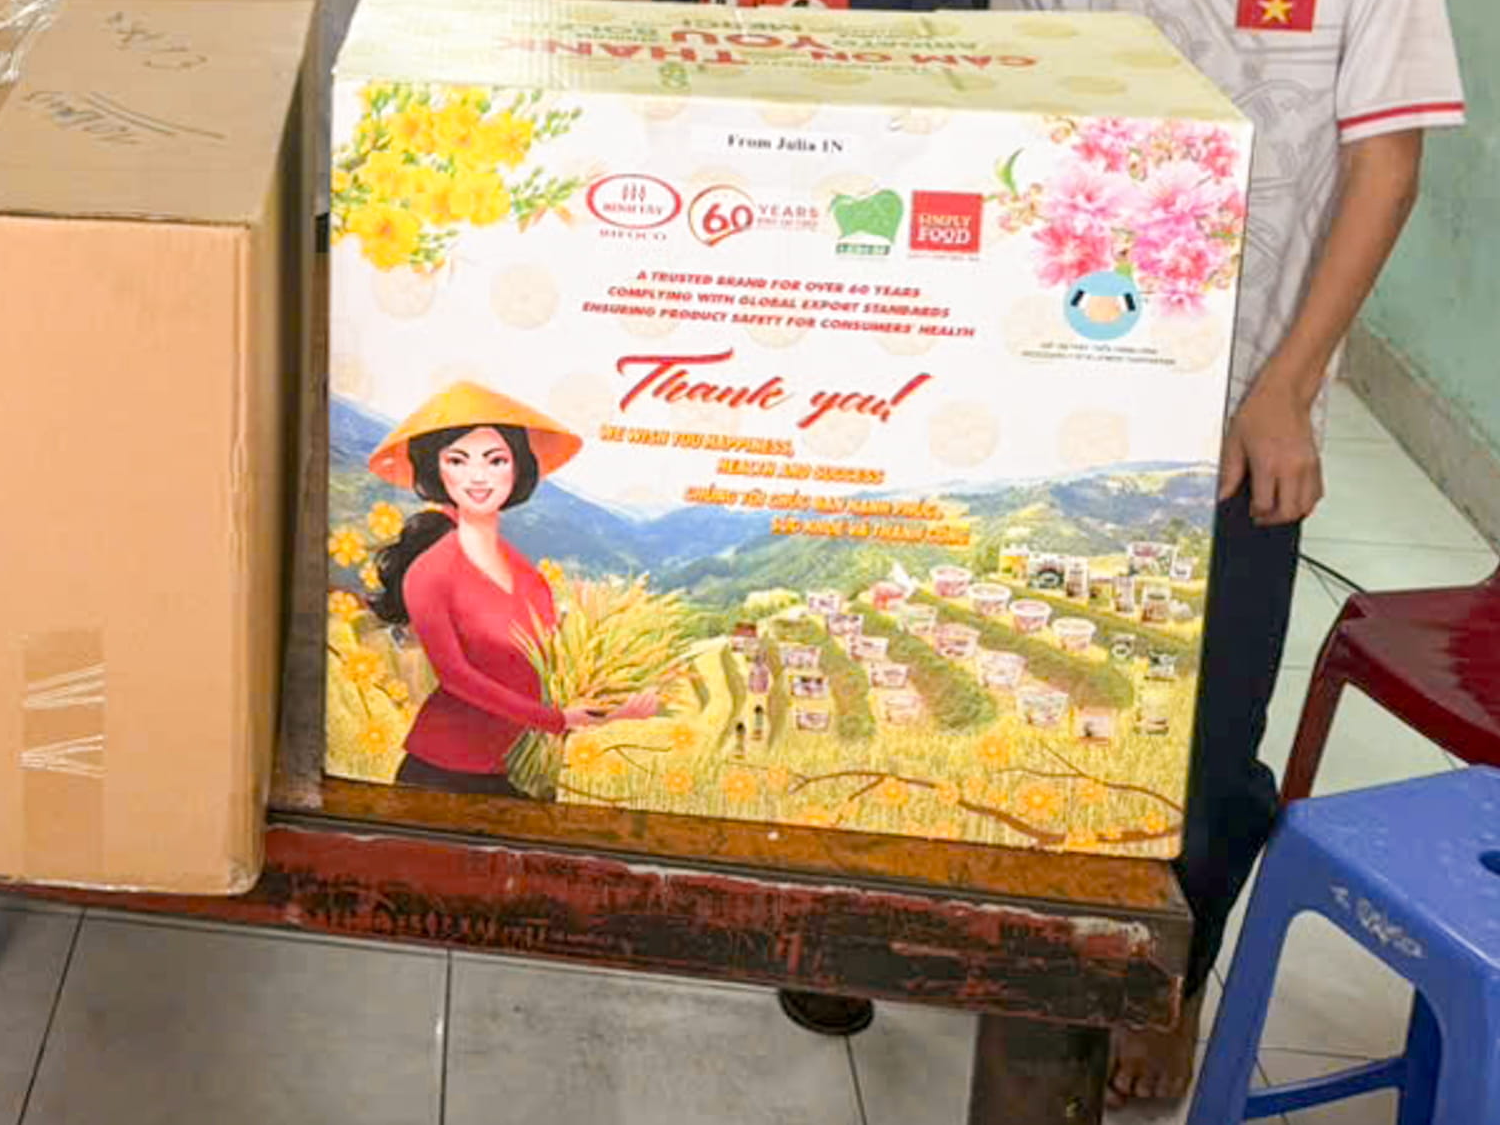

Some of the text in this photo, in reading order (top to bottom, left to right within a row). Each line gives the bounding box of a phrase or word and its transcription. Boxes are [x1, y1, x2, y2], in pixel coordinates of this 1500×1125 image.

[670, 30, 828, 51] YOU
[727, 134, 771, 149] From
[776, 136, 816, 152] Julia
[702, 202, 754, 235] 60
[758, 204, 819, 219] YEARS
[916, 226, 973, 244] FOOD
[637, 269, 921, 298] A TRUSTED BRAND FOR OVER 60 YEARS
[607, 285, 951, 319] COMPLYING WITH GLOBAL EXPORT STANDARDS
[582, 300, 657, 318] ENSURING
[659, 307, 728, 323] PRODUCT
[731, 312, 784, 327] SAFETY
[786, 315, 817, 329] FOR
[918, 324, 976, 338] HEALTH
[616, 347, 934, 429] Thank you!
[627, 426, 670, 446] WISH
[813, 463, 886, 485] SUCCESS
